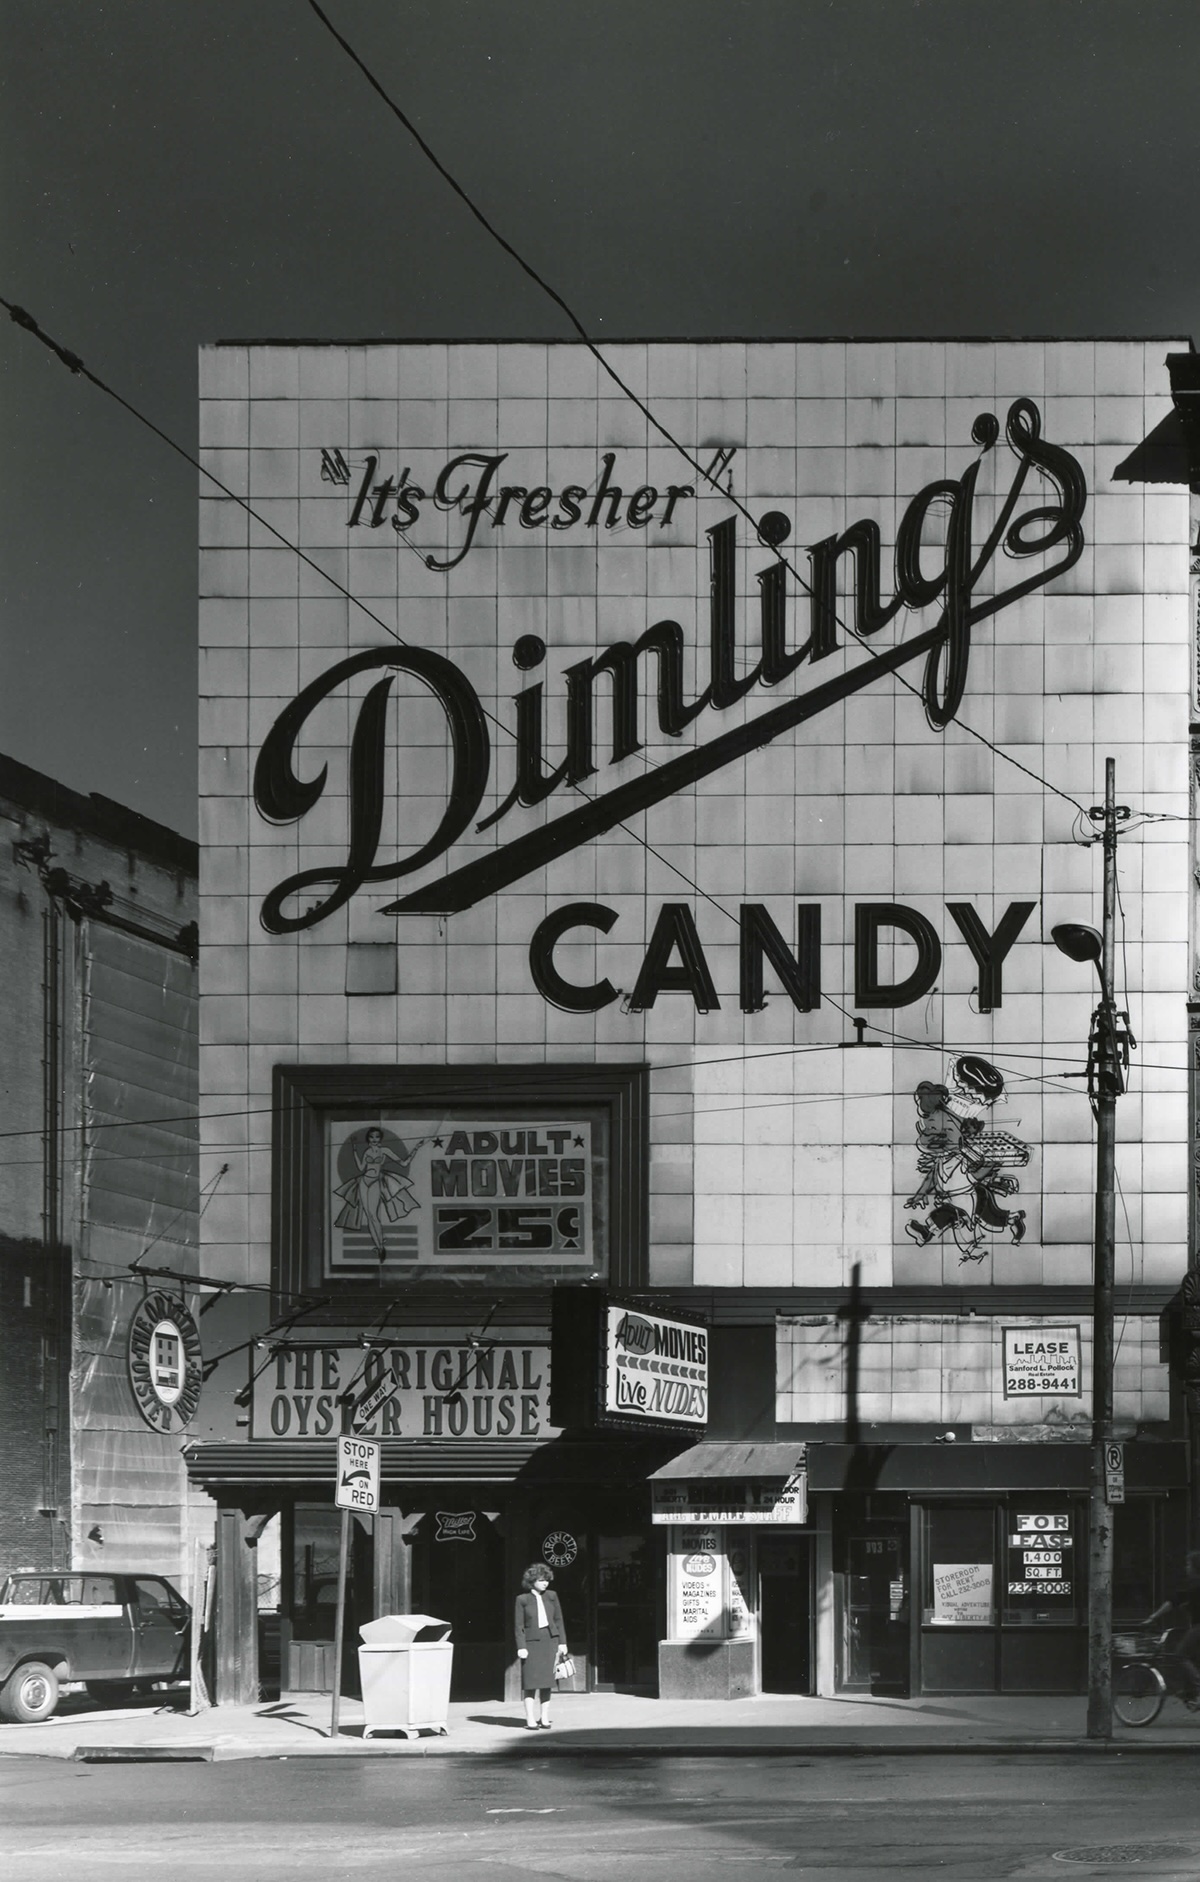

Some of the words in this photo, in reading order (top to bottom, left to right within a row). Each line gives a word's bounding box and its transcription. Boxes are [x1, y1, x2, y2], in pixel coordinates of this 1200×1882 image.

[254, 397, 1087, 934] Dimling's
[529, 902, 1037, 1013] CANDY
[445, 1131, 571, 1155] ADULT
[431, 1159, 586, 1197] MOVIES
[131, 1316, 154, 1354] THE
[615, 1311, 653, 1352] ADULT
[654, 1323, 706, 1365] MOVIES
[1014, 1342, 1069, 1354] LEASE
[272, 1349, 341, 1391] THE
[364, 1348, 542, 1392] ORIGINAL
[616, 1367, 646, 1413] Live
[646, 1377, 708, 1418] NUDES
[1008, 1378, 1076, 1390] 288-9441
[131, 1360, 173, 1431] OYSTER
[173, 1367, 202, 1425] HOUSE
[359, 1399, 374, 1418] ONE
[373, 1383, 387, 1402] WAY
[270, 1394, 403, 1436] OYSTR
[422, 1395, 540, 1436] HOUSE
[344, 1441, 374, 1459] STOP
[350, 1458, 368, 1469] HERE
[359, 1480, 369, 1489] ON
[352, 1490, 374, 1506] RED
[441, 1516, 473, 1528] Miller
[750, 1504, 793, 1522] STAFF
[1017, 1516, 1068, 1529] FOR
[544, 1532, 562, 1554] IRON
[562, 1533, 577, 1554] CITY
[682, 1538, 717, 1550] MOVIES
[1009, 1535, 1072, 1549] LEASE
[547, 1553, 573, 1566] BEER
[686, 1563, 713, 1573] NUDES
[935, 1566, 980, 1586] STOREROOM
[1025, 1567, 1042, 1578] SQ.
[1046, 1567, 1061, 1577] FT.
[682, 1581, 705, 1589] VIDEOS
[937, 1582, 953, 1593] FOR
[955, 1575, 974, 1587] RENT
[940, 1589, 958, 1600] CALL
[958, 1578, 991, 1595] 232-3008
[1009, 1582, 1071, 1594] 232-3008
[682, 1590, 716, 1598] MAGAZINES
[682, 1599, 700, 1607] GIFTS
